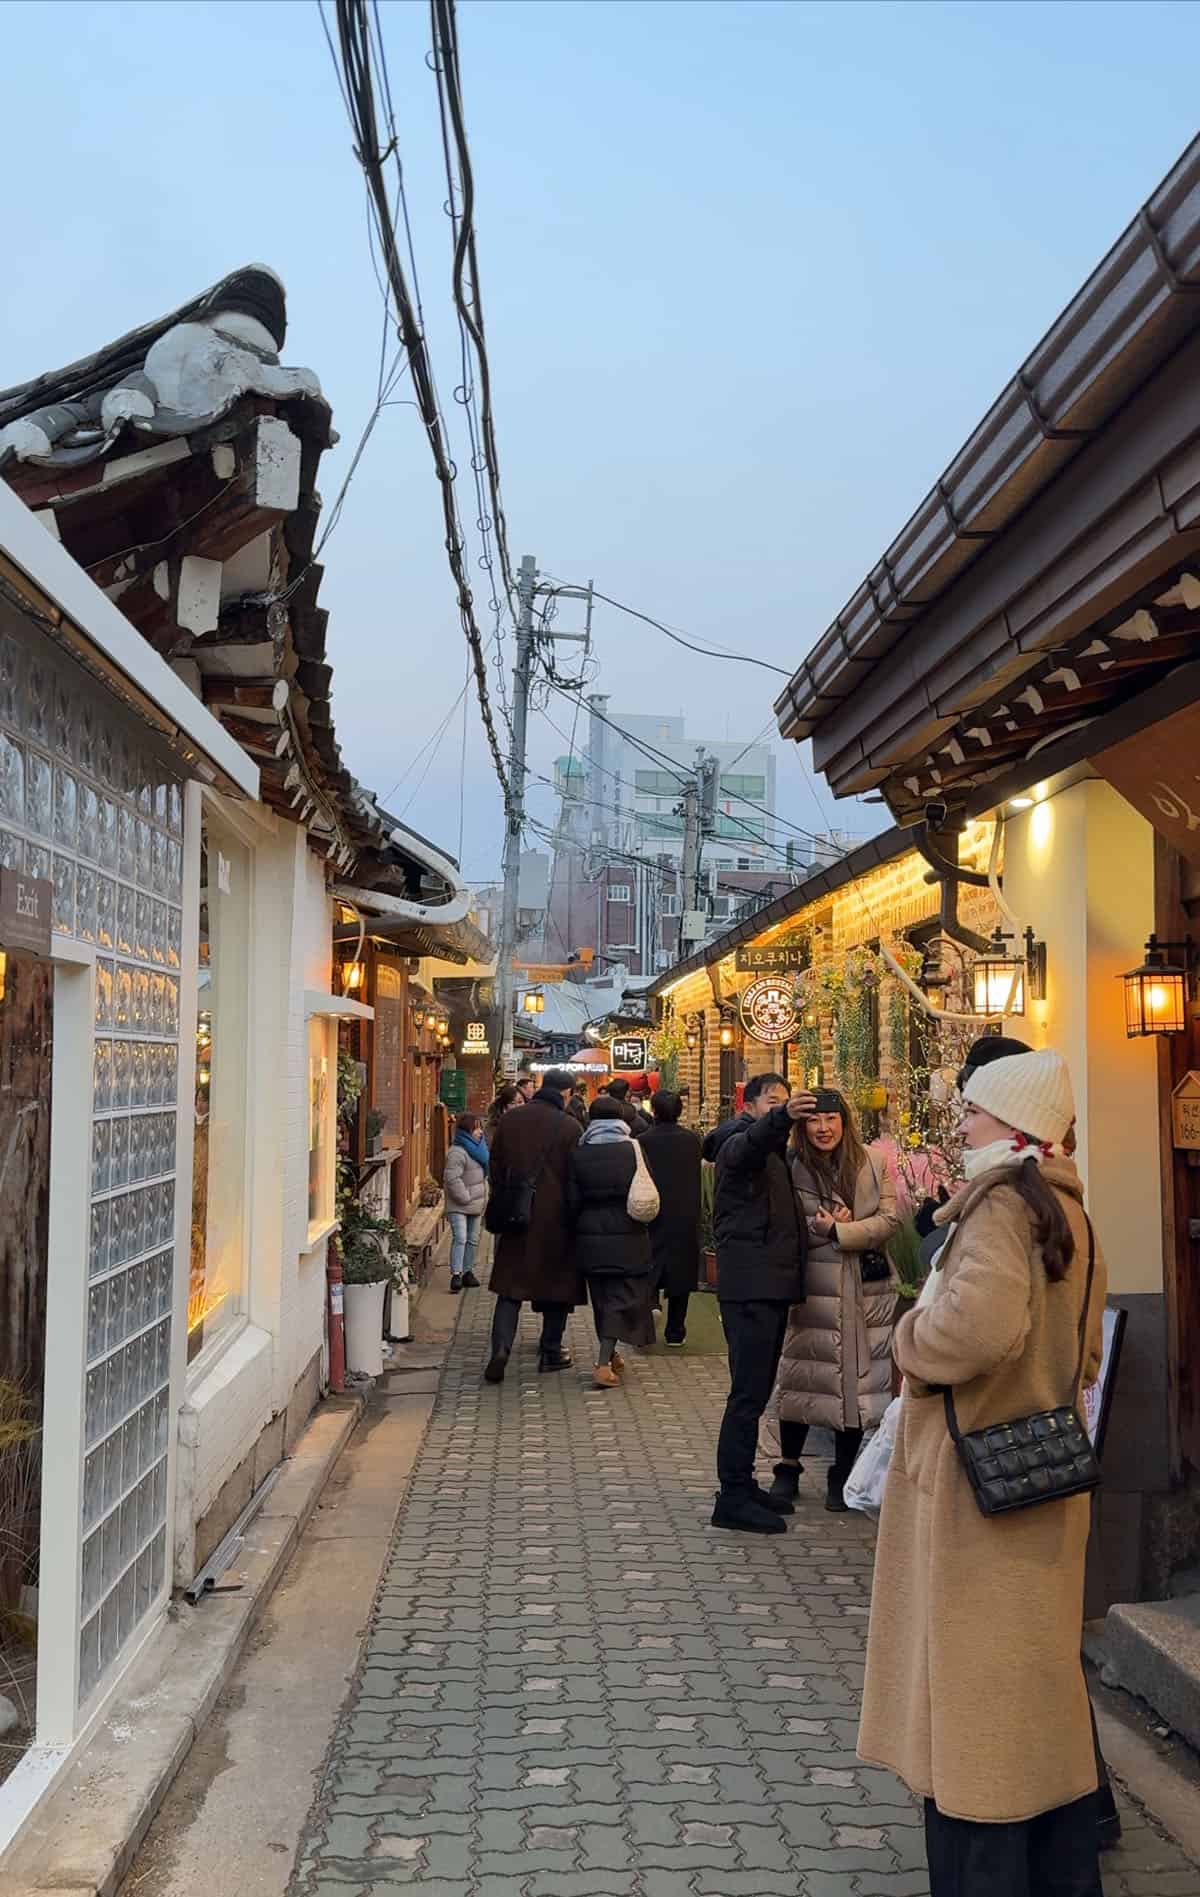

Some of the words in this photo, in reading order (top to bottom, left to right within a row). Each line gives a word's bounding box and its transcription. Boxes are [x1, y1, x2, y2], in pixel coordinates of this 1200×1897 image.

[16, 883, 39, 919] Exit
[740, 951, 803, 966] 지오쿠치나
[750, 1024, 771, 1040] PIZZA
[614, 1042, 644, 1065] 마당
